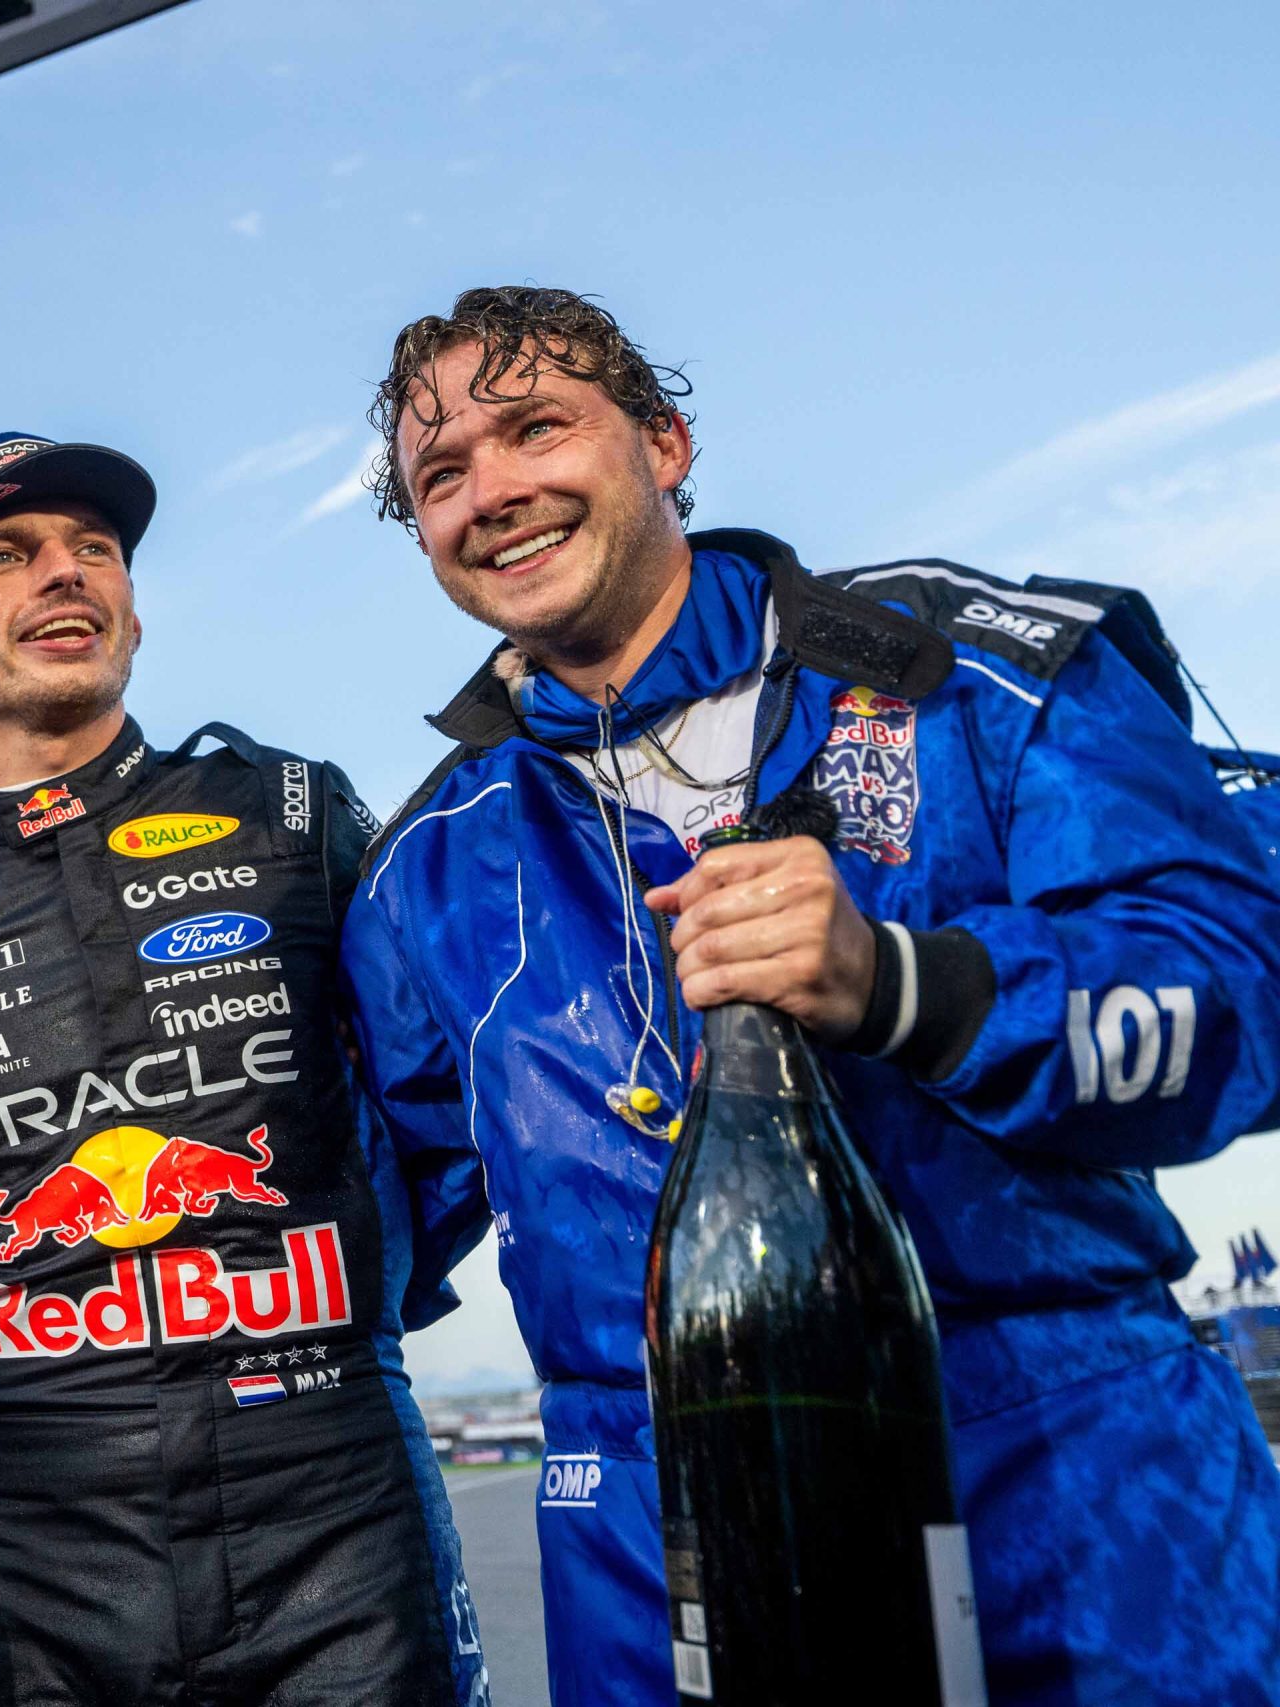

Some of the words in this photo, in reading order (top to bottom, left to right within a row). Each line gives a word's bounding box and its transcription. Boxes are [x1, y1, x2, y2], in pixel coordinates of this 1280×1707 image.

[962, 603, 1056, 643] OMP
[826, 718, 869, 745] ed
[116, 744, 145, 778] DAM
[814, 745, 913, 791] MAX
[283, 761, 311, 833] sparco
[18, 811, 53, 839] Red
[53, 797, 87, 830] Bull
[143, 821, 224, 847] RAUCH
[0, 944, 14, 967] 1
[167, 919, 247, 957] Ford
[144, 957, 283, 993] RACING
[150, 982, 291, 1038] indeed
[1066, 984, 1197, 1105] 101
[152, 1221, 352, 1346] Bull
[294, 1367, 341, 1394] MAX
[545, 1463, 602, 1499] OMP
